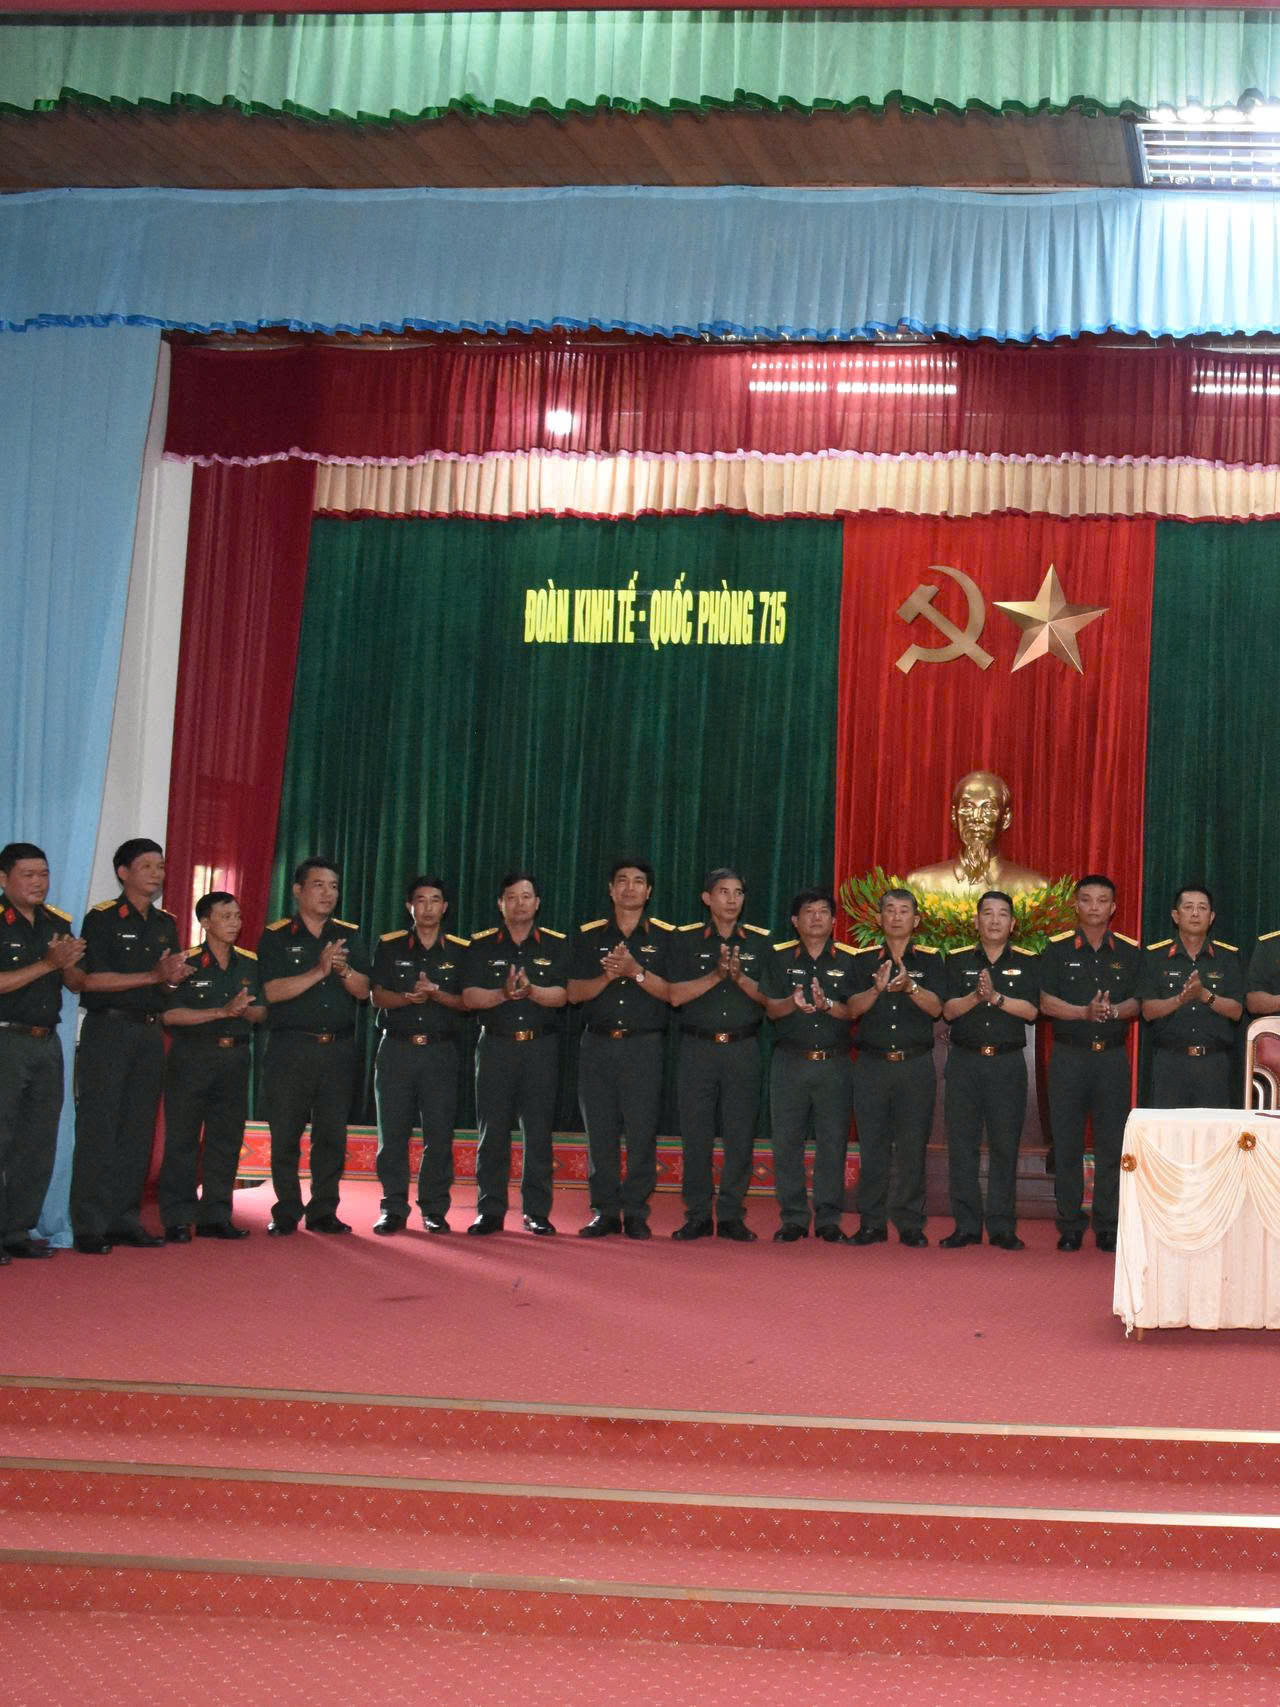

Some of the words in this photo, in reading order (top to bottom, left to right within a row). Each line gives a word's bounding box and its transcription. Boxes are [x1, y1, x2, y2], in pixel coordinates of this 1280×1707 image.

[524, 578, 570, 643] ĐOÀN
[573, 589, 615, 643] KINH
[617, 570, 639, 643] TẾ
[650, 572, 694, 650] QUỐC
[697, 579, 754, 645] PHÒNG
[759, 591, 787, 644] 715
